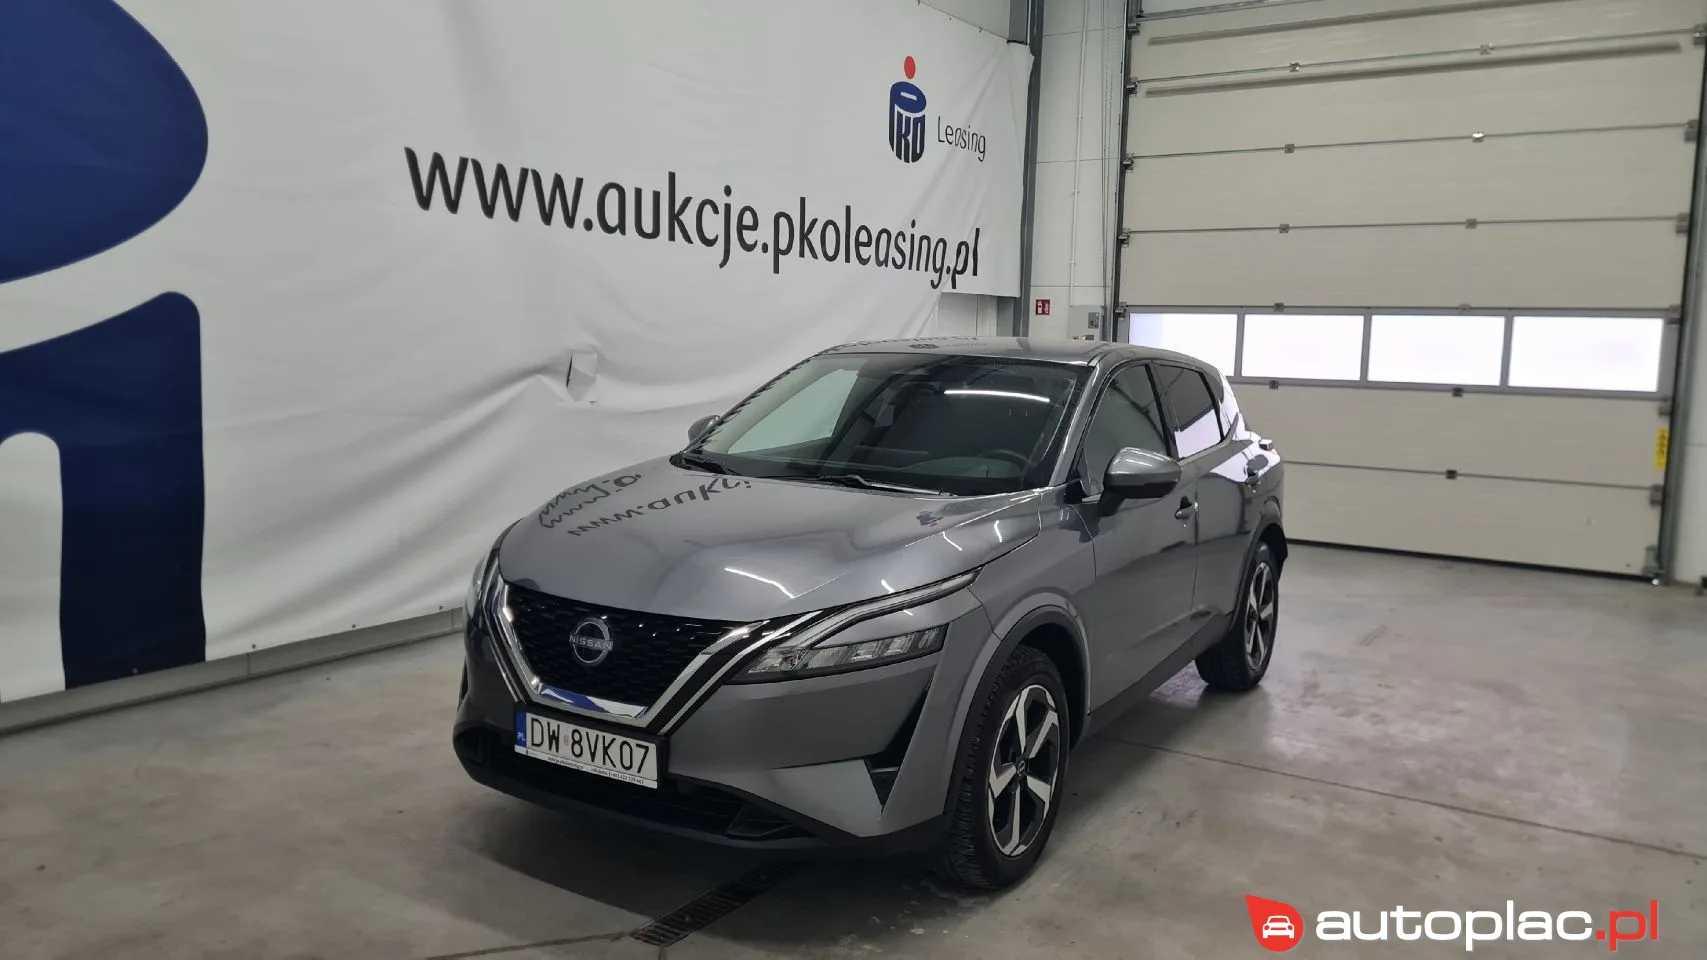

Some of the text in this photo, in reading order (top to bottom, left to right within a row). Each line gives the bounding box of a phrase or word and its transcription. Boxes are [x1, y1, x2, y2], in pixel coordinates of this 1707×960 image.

[938, 115, 986, 162] Leasing
[404, 146, 981, 290] www.aukcje.pkoleasing.pl
[569, 634, 613, 651] NISSAN
[530, 717, 650, 774] DW 8VK07
